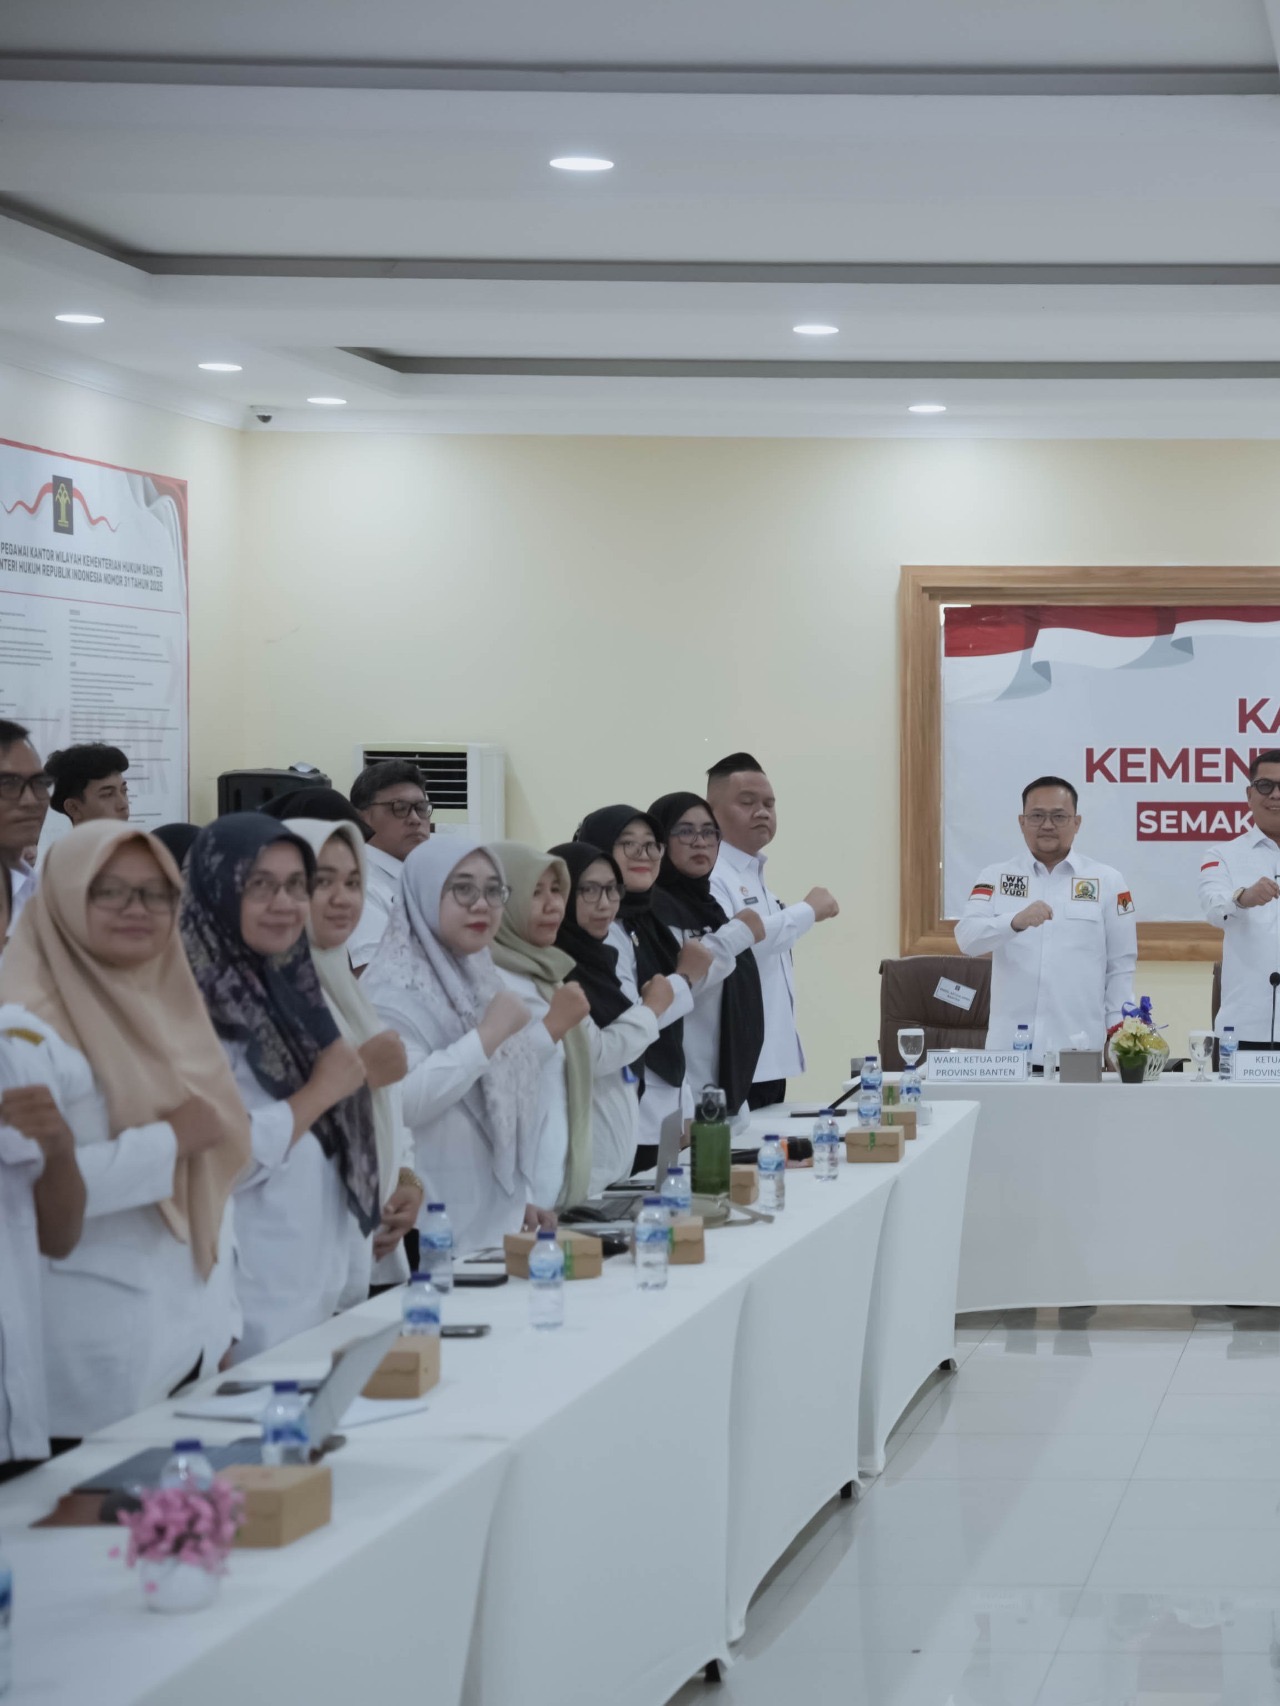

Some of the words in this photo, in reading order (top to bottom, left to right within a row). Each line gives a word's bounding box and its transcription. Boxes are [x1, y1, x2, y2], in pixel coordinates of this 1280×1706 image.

[1, 542, 29, 557] PEGAWAI
[30, 546, 54, 561] KANTOR
[55, 550, 82, 565] WILAYAH
[83, 554, 121, 571] KEMENTERIAN
[122, 561, 141, 574] HUKUM
[142, 564, 163, 577] BANTEN
[0, 558, 17, 572] NTERI
[19, 560, 41, 575] HUKUM
[42, 563, 71, 579] REPUBLIK
[72, 568, 102, 583] INDONESIA
[103, 572, 123, 587] NOMOR
[150, 579, 163, 592] 2025
[1139, 810, 1254, 834] SEMAK
[1006, 875, 1024, 885] WK
[1002, 881, 1026, 890] DPRD
[1004, 888, 1025, 897] YUDI
[934, 1056, 961, 1064] WAKIL
[995, 1055, 1019, 1063] DPRD
[936, 1068, 977, 1077] PROVINSI
[980, 1068, 1015, 1077] BANTEN
